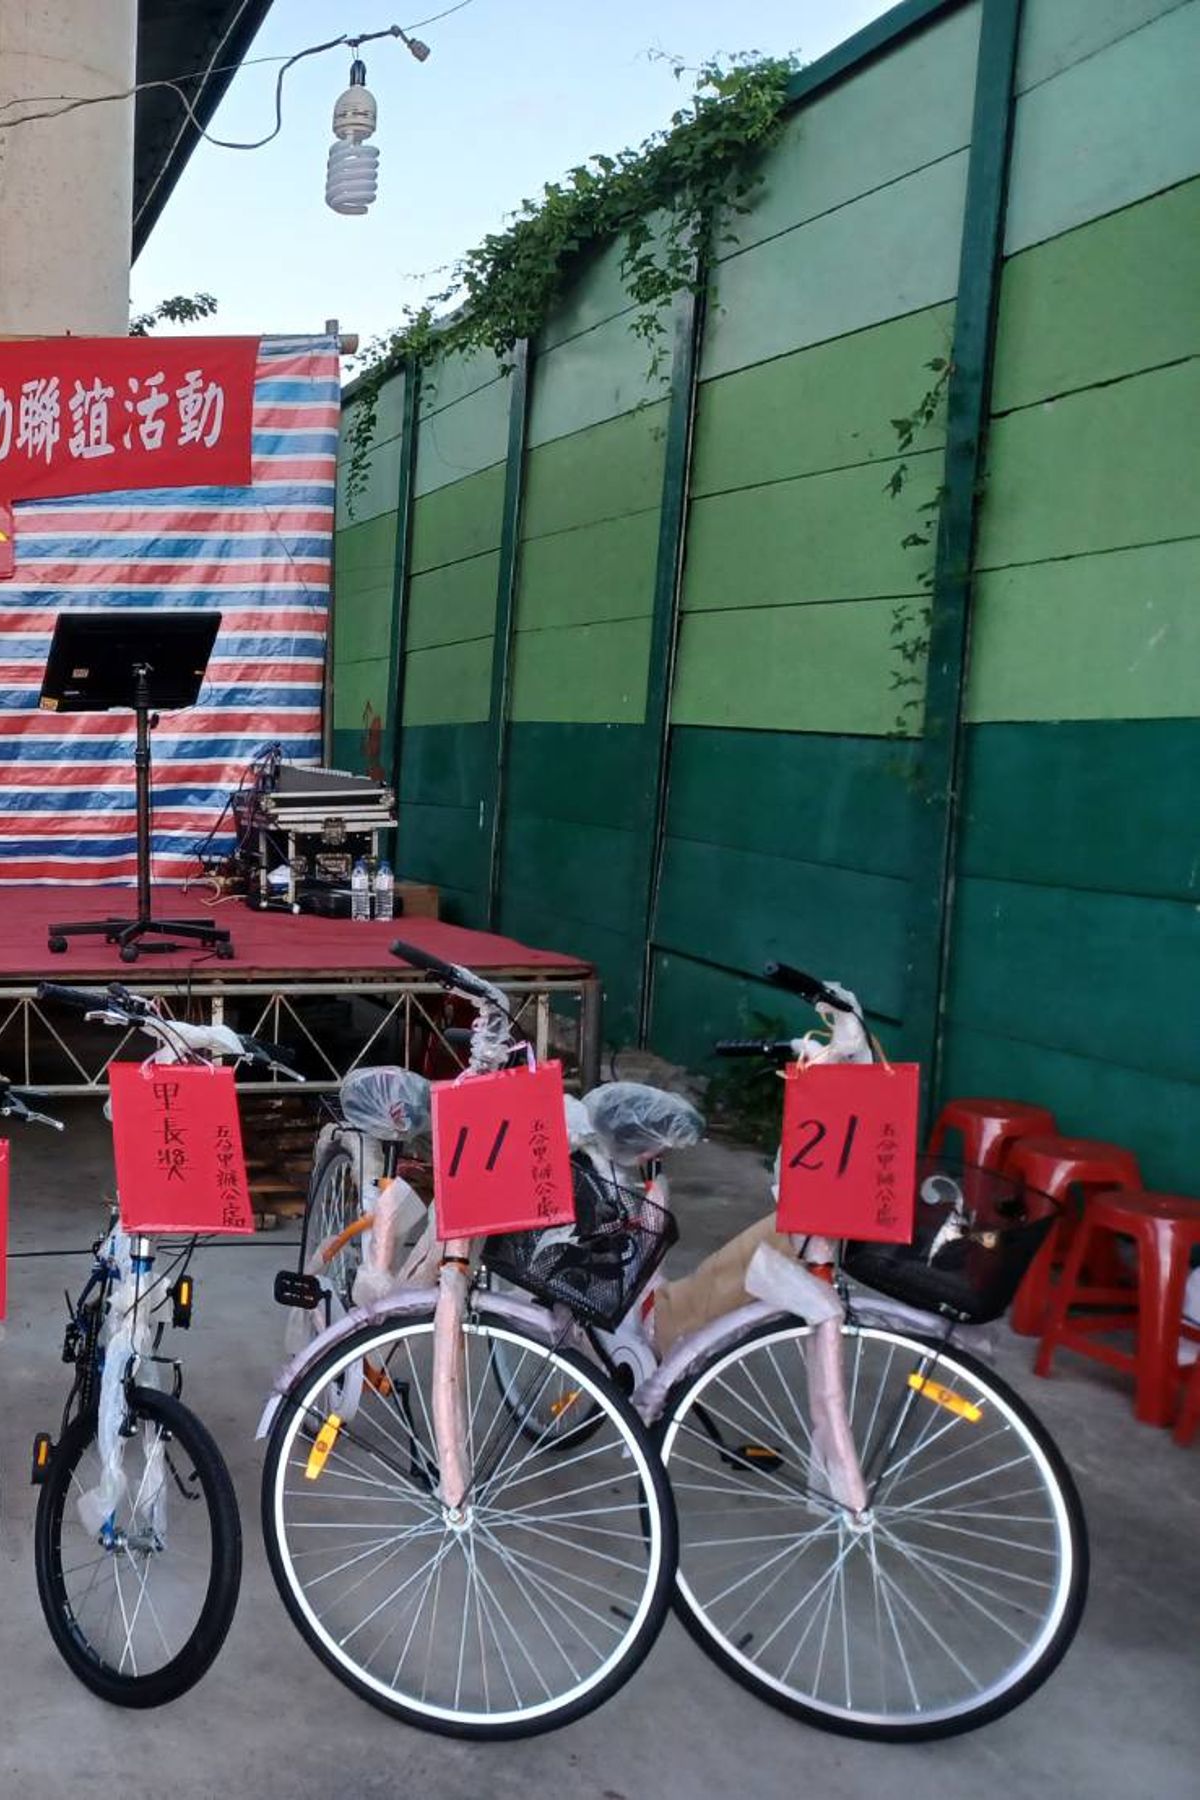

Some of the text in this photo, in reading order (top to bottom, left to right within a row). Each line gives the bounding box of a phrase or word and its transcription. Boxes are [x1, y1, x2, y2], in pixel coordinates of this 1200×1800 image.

[152, 1082, 196, 1182] 里長獎
[448, 1119, 510, 1178] 11
[788, 1114, 859, 1179] 21
